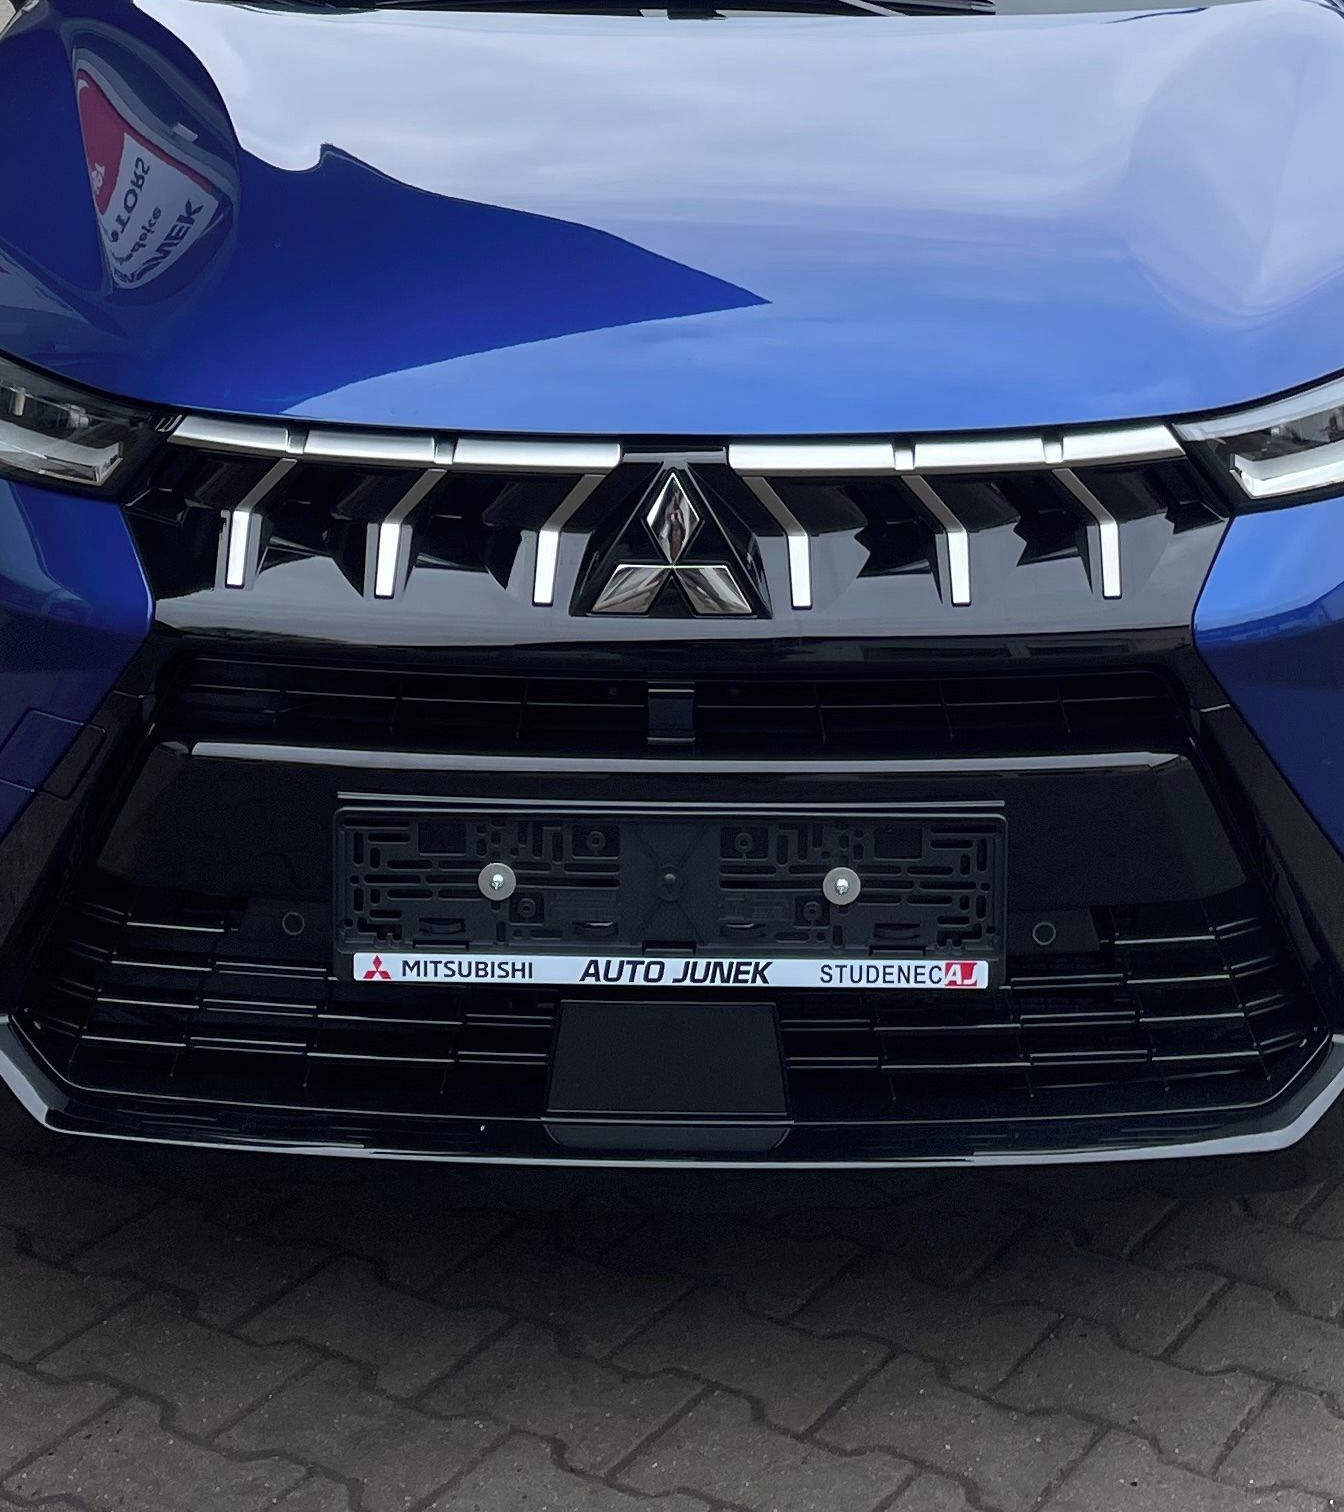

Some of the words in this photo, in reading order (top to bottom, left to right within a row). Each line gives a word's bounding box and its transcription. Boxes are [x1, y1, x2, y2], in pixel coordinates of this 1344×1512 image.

[400, 959, 534, 981] MITSUBISHI
[578, 959, 665, 984] AUTO
[671, 960, 774, 985] JUNEK
[819, 963, 944, 985] STUDENEC
